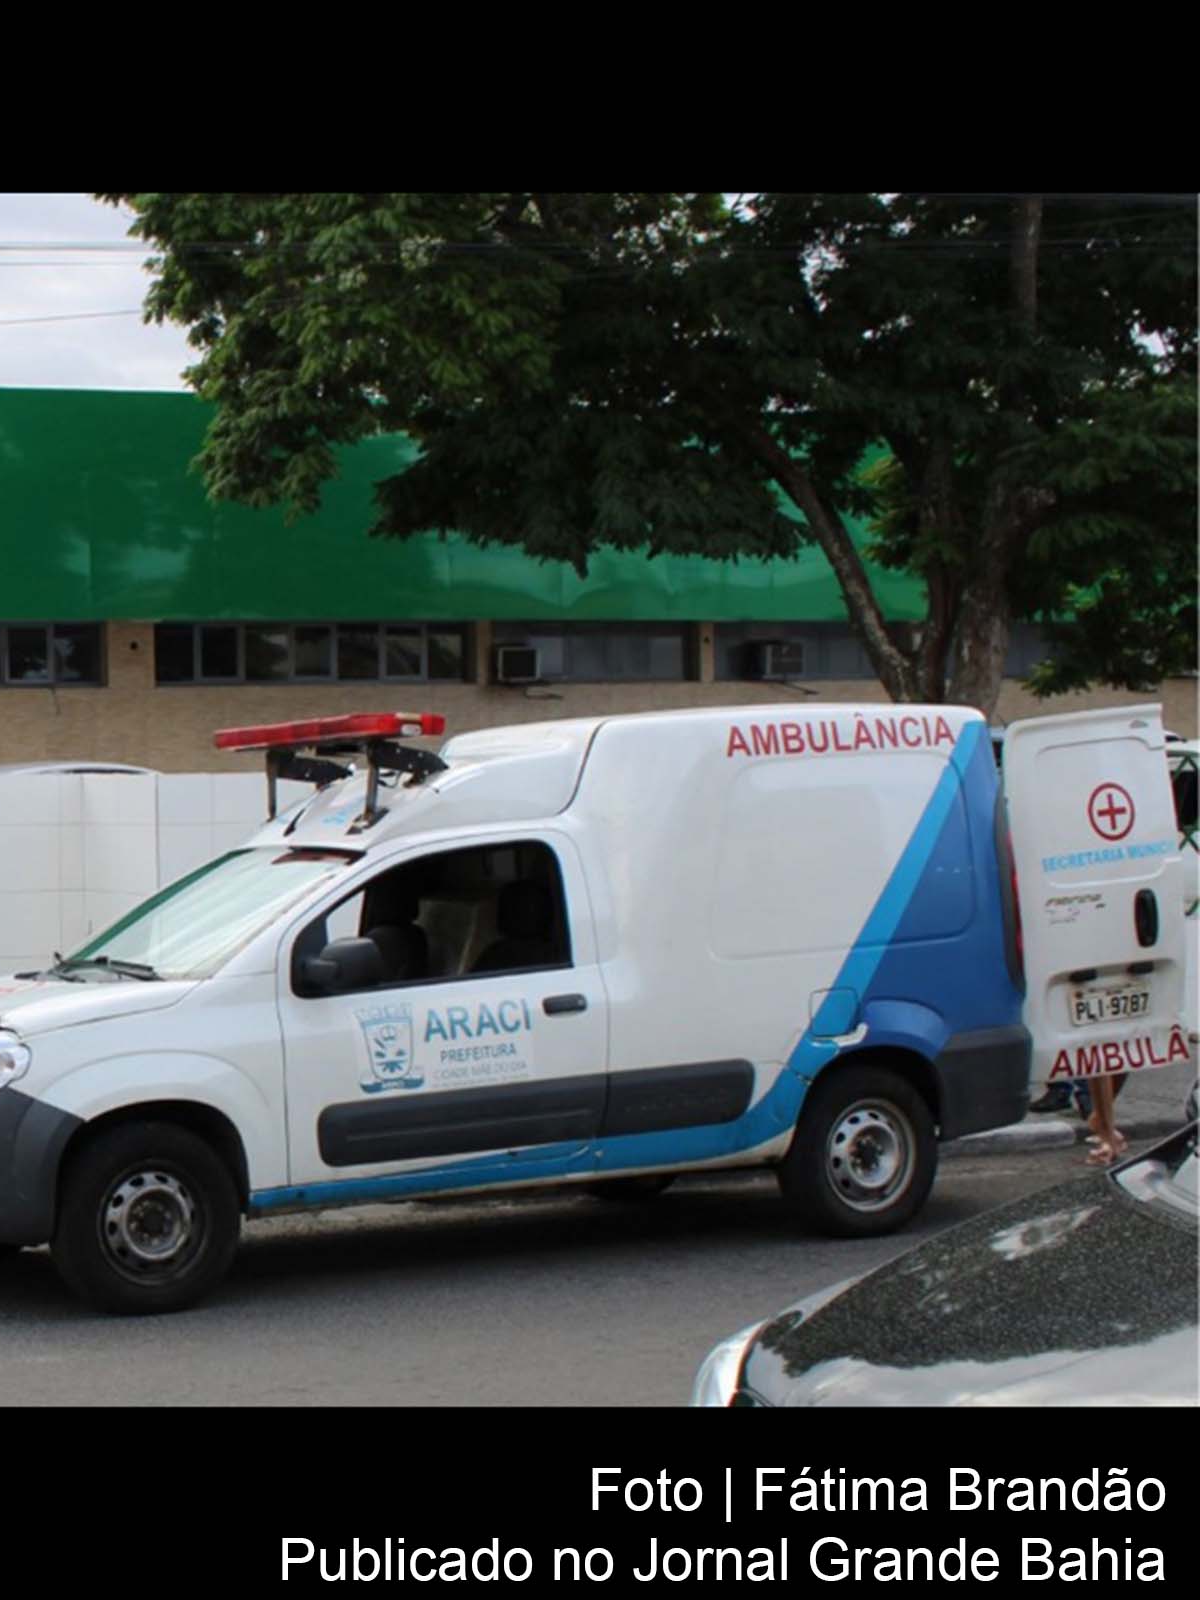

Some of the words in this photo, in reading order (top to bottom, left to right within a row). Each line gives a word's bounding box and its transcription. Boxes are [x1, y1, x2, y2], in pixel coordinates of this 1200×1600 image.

[727, 712, 955, 757] AMBULÂNCIA
[1042, 847, 1124, 872] SECRETARIA
[424, 999, 531, 1042] ARACI
[440, 1043, 517, 1062] PREFEITURA
[1049, 1024, 1190, 1079] AMBULÂ
